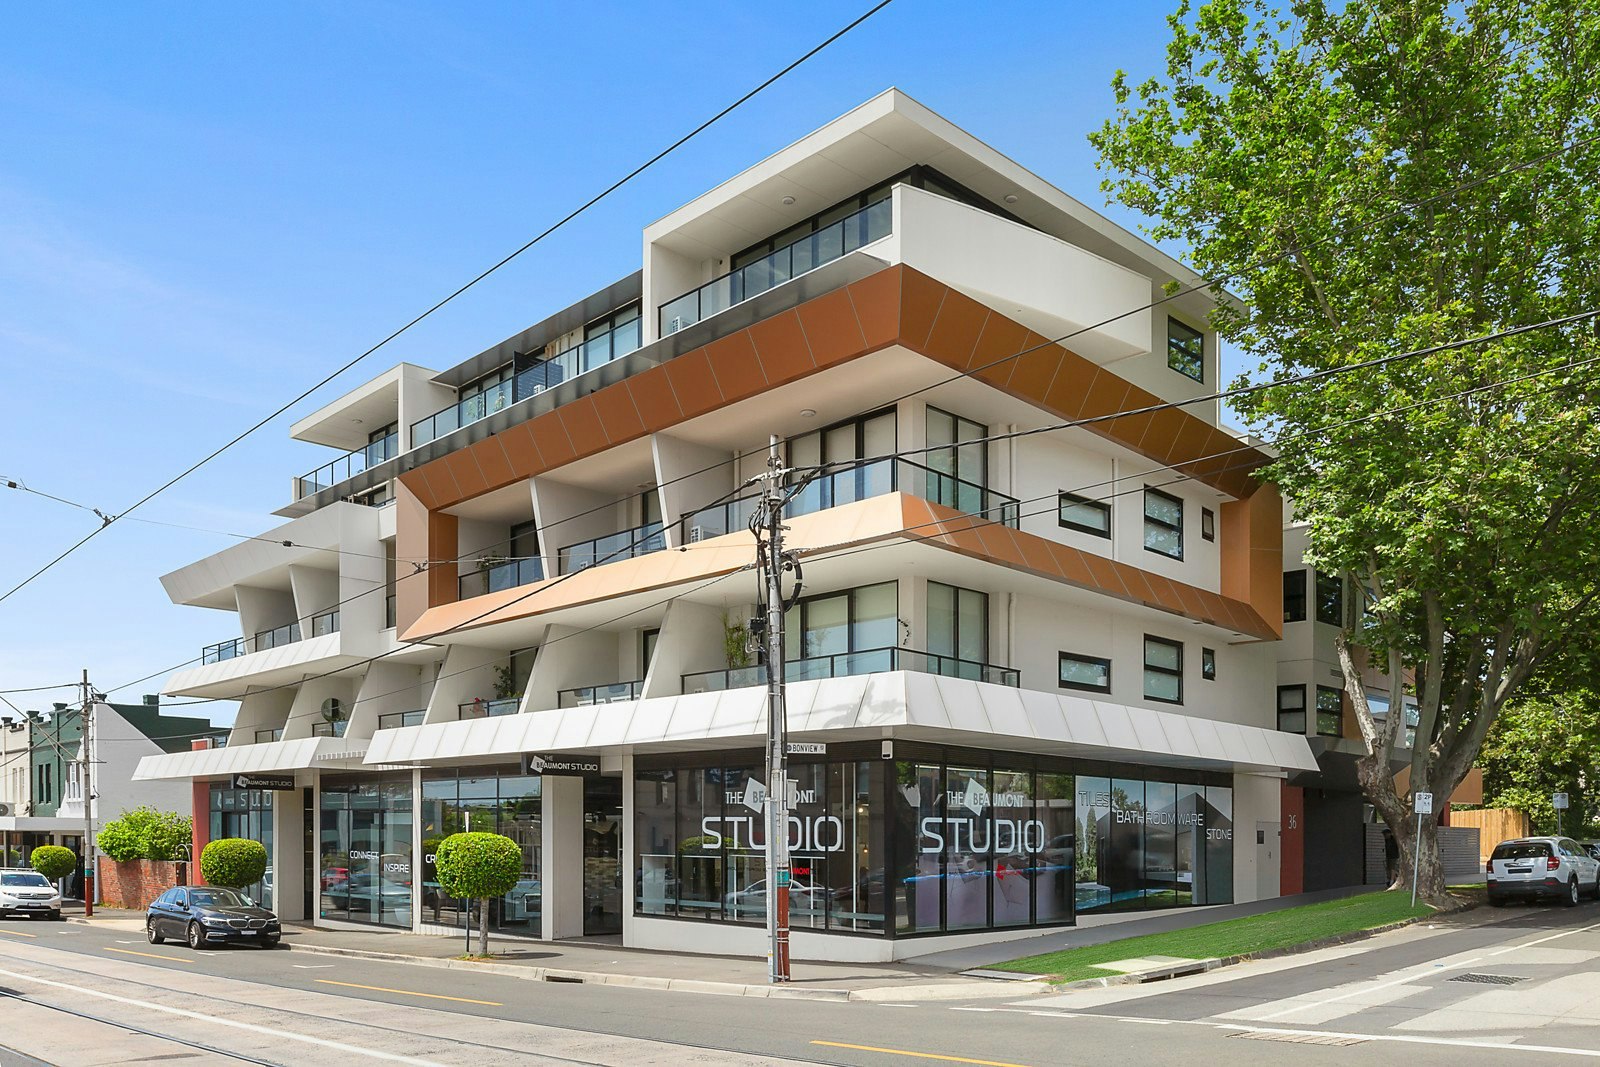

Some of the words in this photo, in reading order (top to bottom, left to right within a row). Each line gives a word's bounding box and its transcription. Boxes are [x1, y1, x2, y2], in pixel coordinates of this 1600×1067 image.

[792, 744, 818, 753] BONVIEW
[571, 763, 598, 771] STUDIO
[725, 791, 743, 804] THE
[946, 790, 963, 805] THE
[973, 792, 1024, 808] BEAUMONT
[1078, 790, 1110, 808] TILES
[1288, 814, 1297, 829] 36
[921, 817, 1045, 853] STUDIO
[1205, 828, 1232, 840] STONE
[349, 850, 380, 860] CONNECT
[383, 863, 410, 874] INSPIRE
